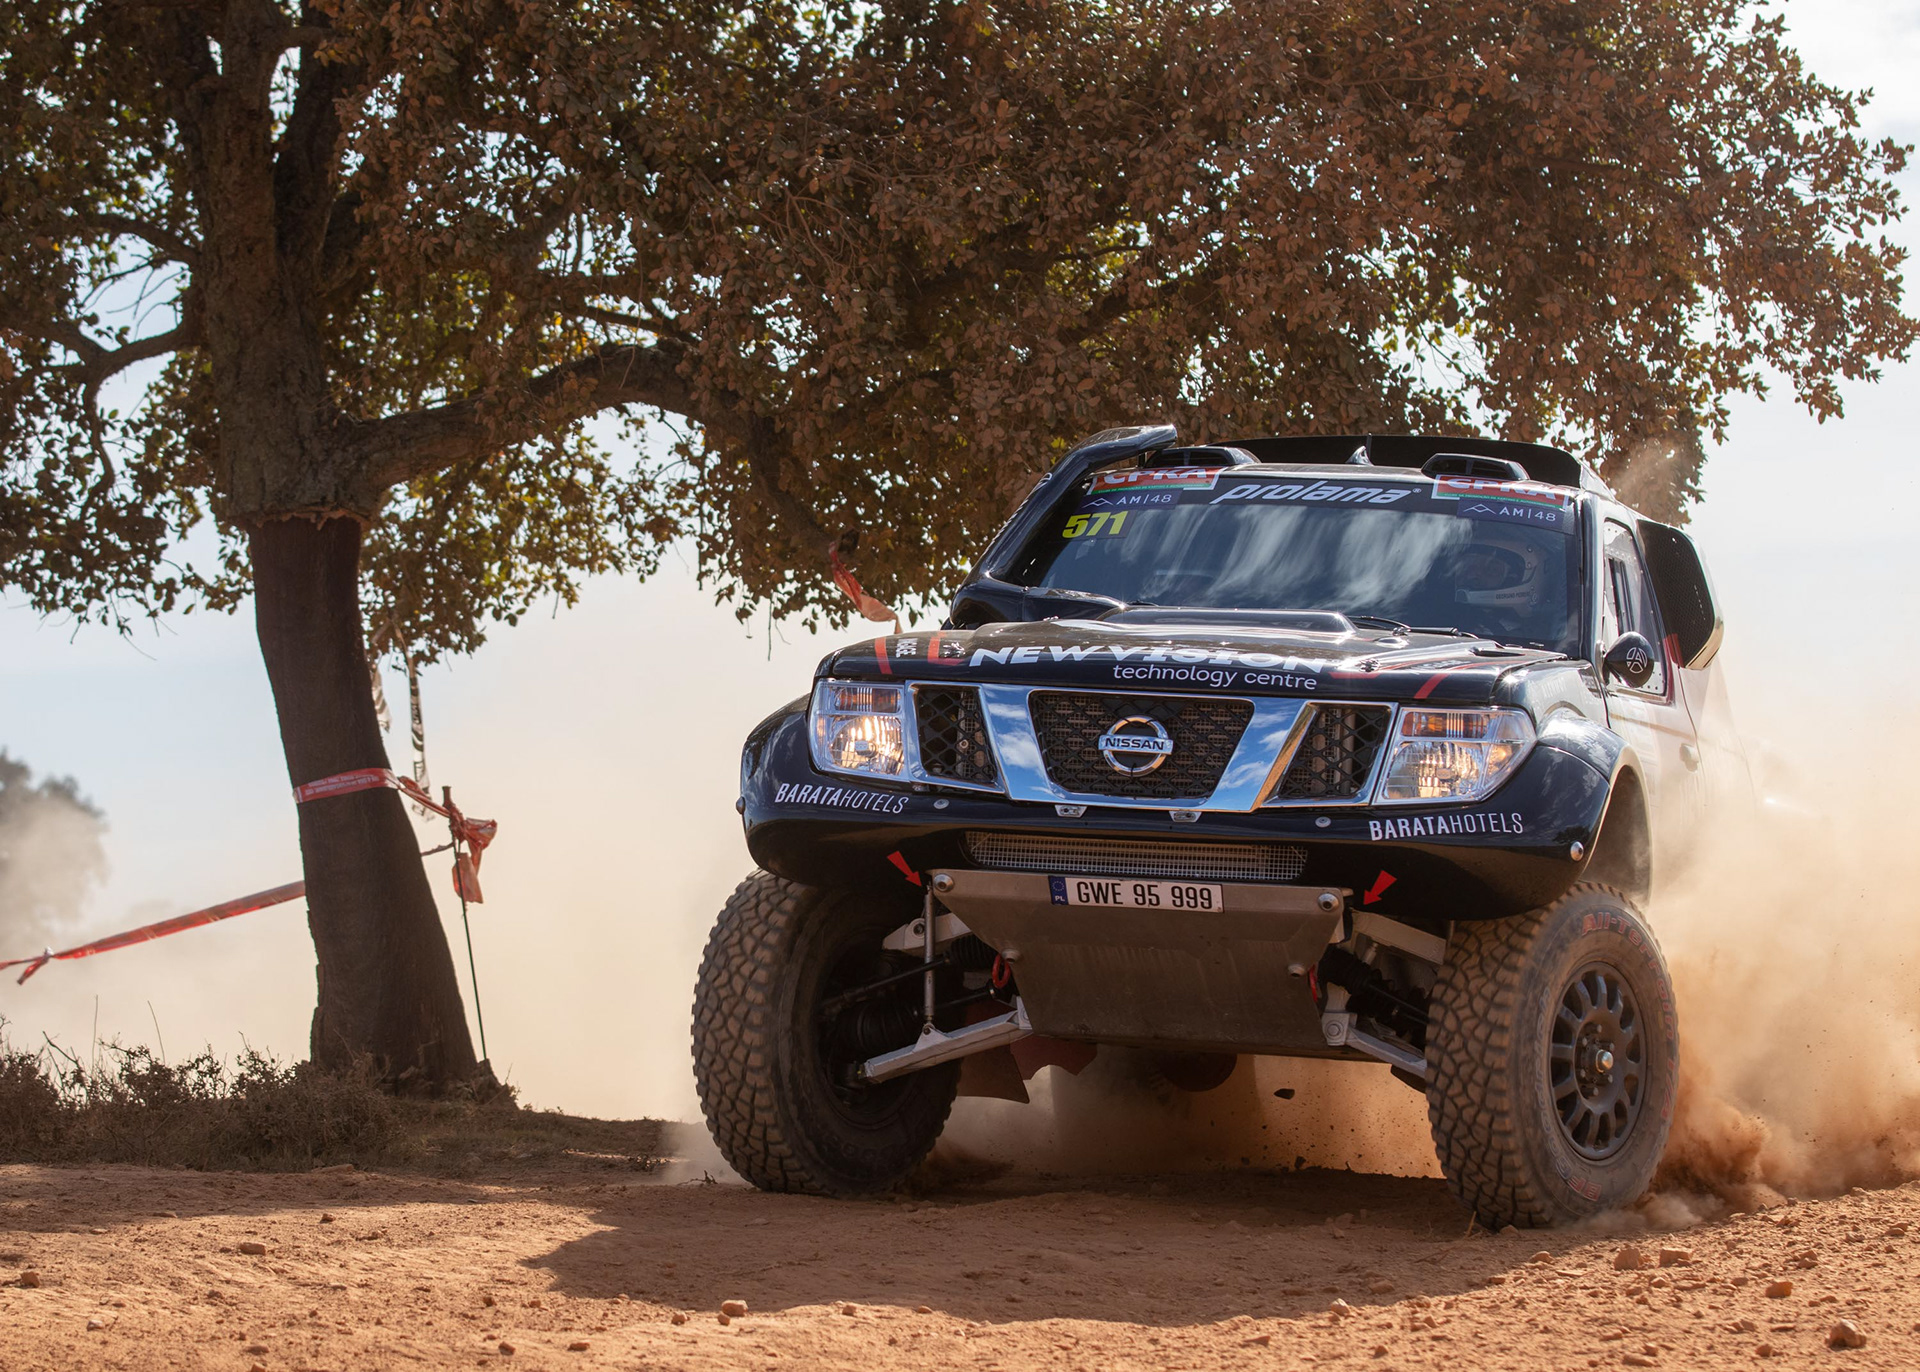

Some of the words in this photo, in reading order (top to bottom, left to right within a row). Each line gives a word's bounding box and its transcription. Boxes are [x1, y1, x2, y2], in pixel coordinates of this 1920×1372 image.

[1062, 510, 1129, 539] 571
[1113, 664, 1238, 688] technology
[1244, 670, 1318, 690] centre
[1105, 737, 1164, 750] NISSAN
[774, 783, 910, 814] BARATAHOTELS
[1369, 813, 1524, 841] BARATAHOTELS
[1076, 881, 1124, 905] GWE
[1133, 883, 1161, 906] 95
[1171, 886, 1213, 909] 999
